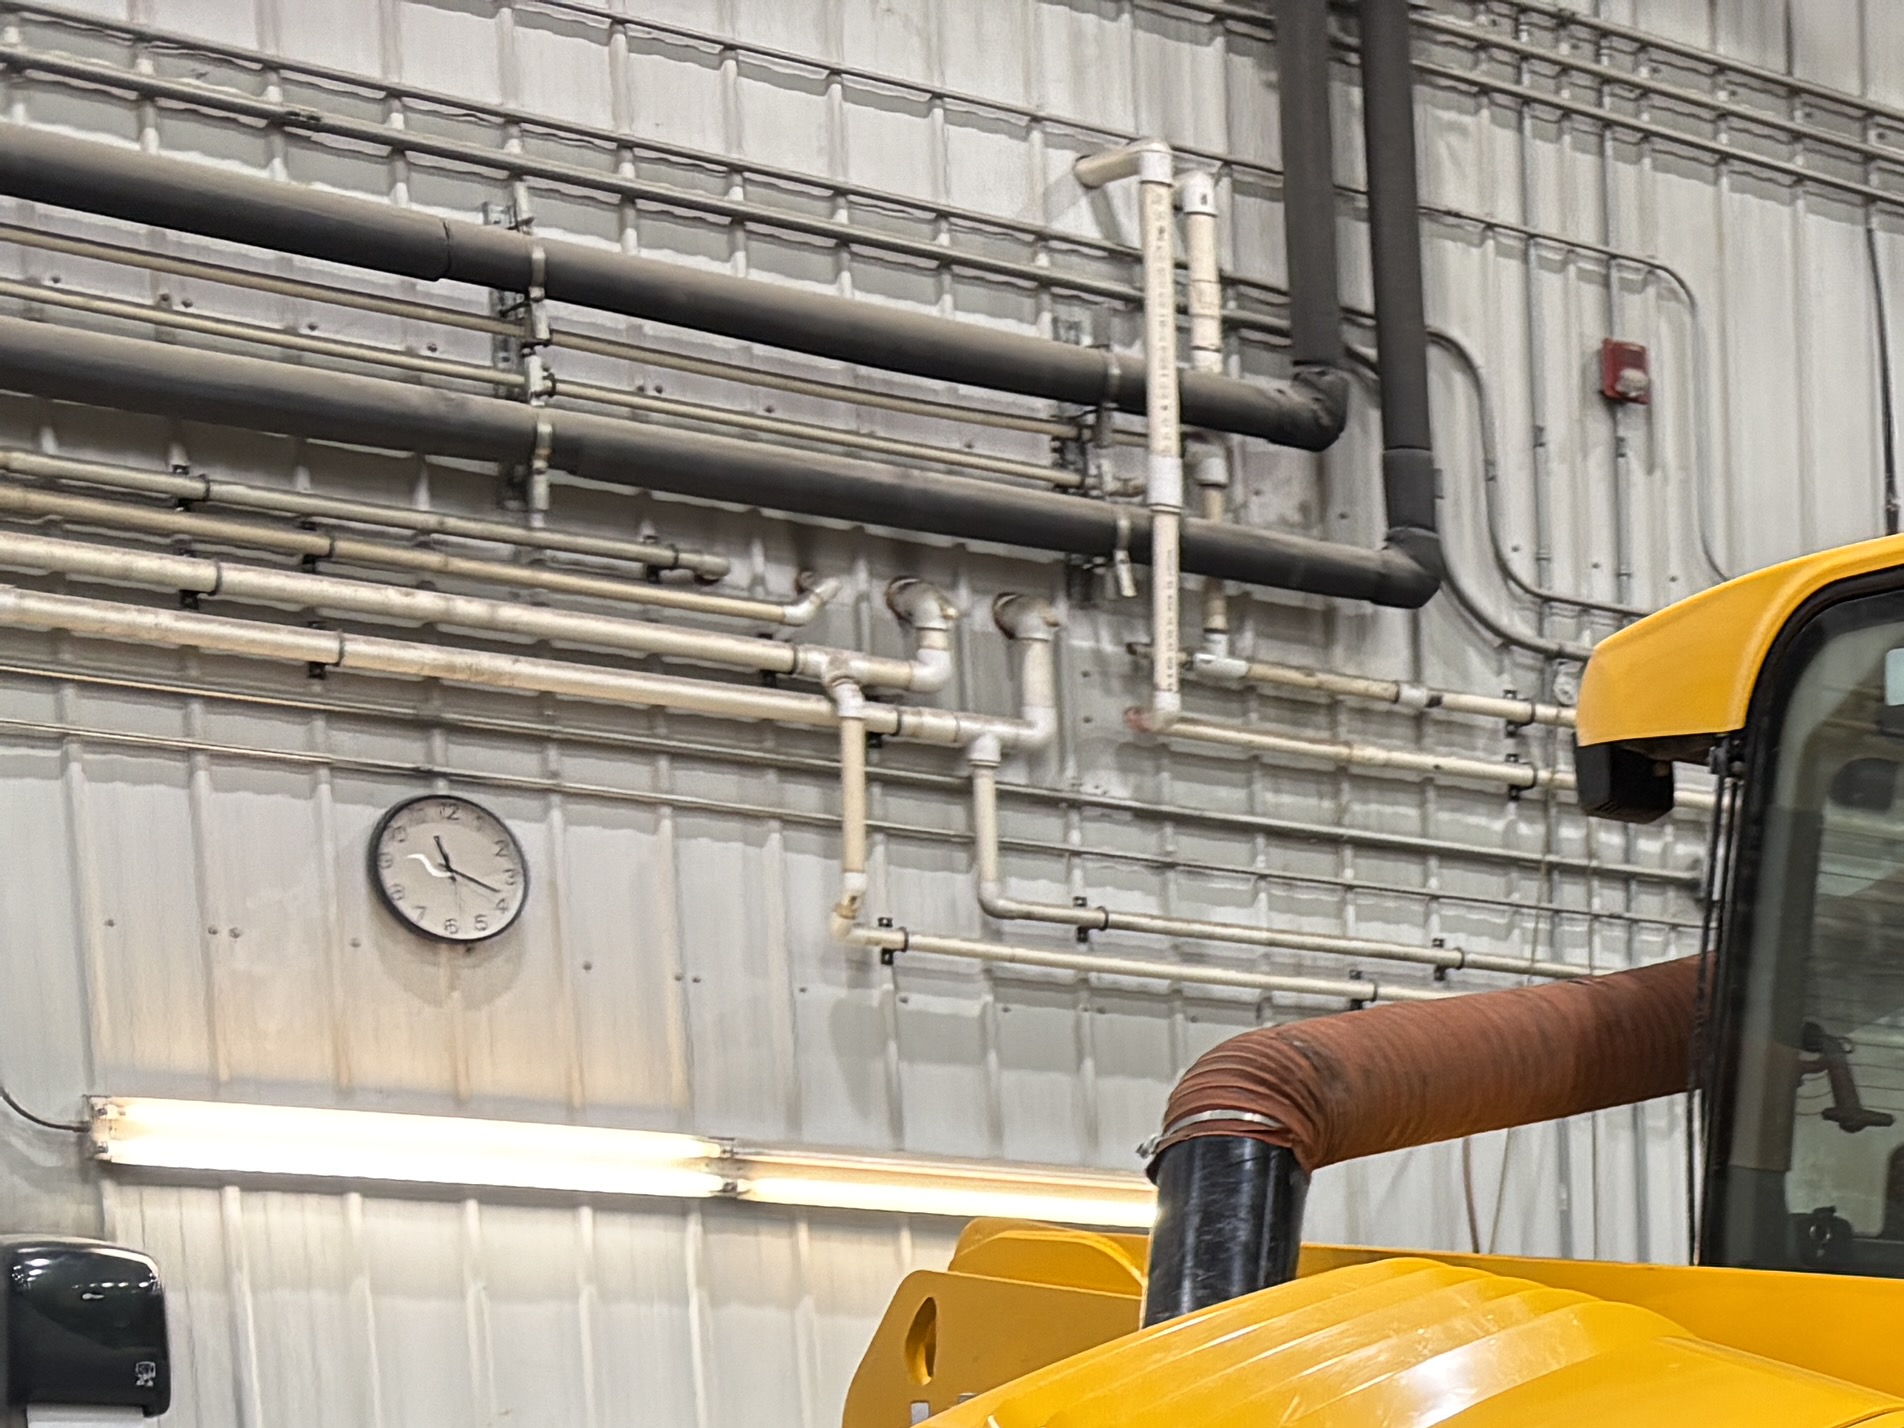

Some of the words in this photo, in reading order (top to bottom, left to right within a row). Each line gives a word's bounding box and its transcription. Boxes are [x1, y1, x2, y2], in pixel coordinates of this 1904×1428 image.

[440, 803, 459, 820] 12
[494, 840, 508, 857] 2
[504, 868, 516, 886] 3
[414, 905, 427, 921] 7
[495, 898, 509, 914] 4
[444, 918, 458, 934] 6
[474, 914, 488, 931] 5
